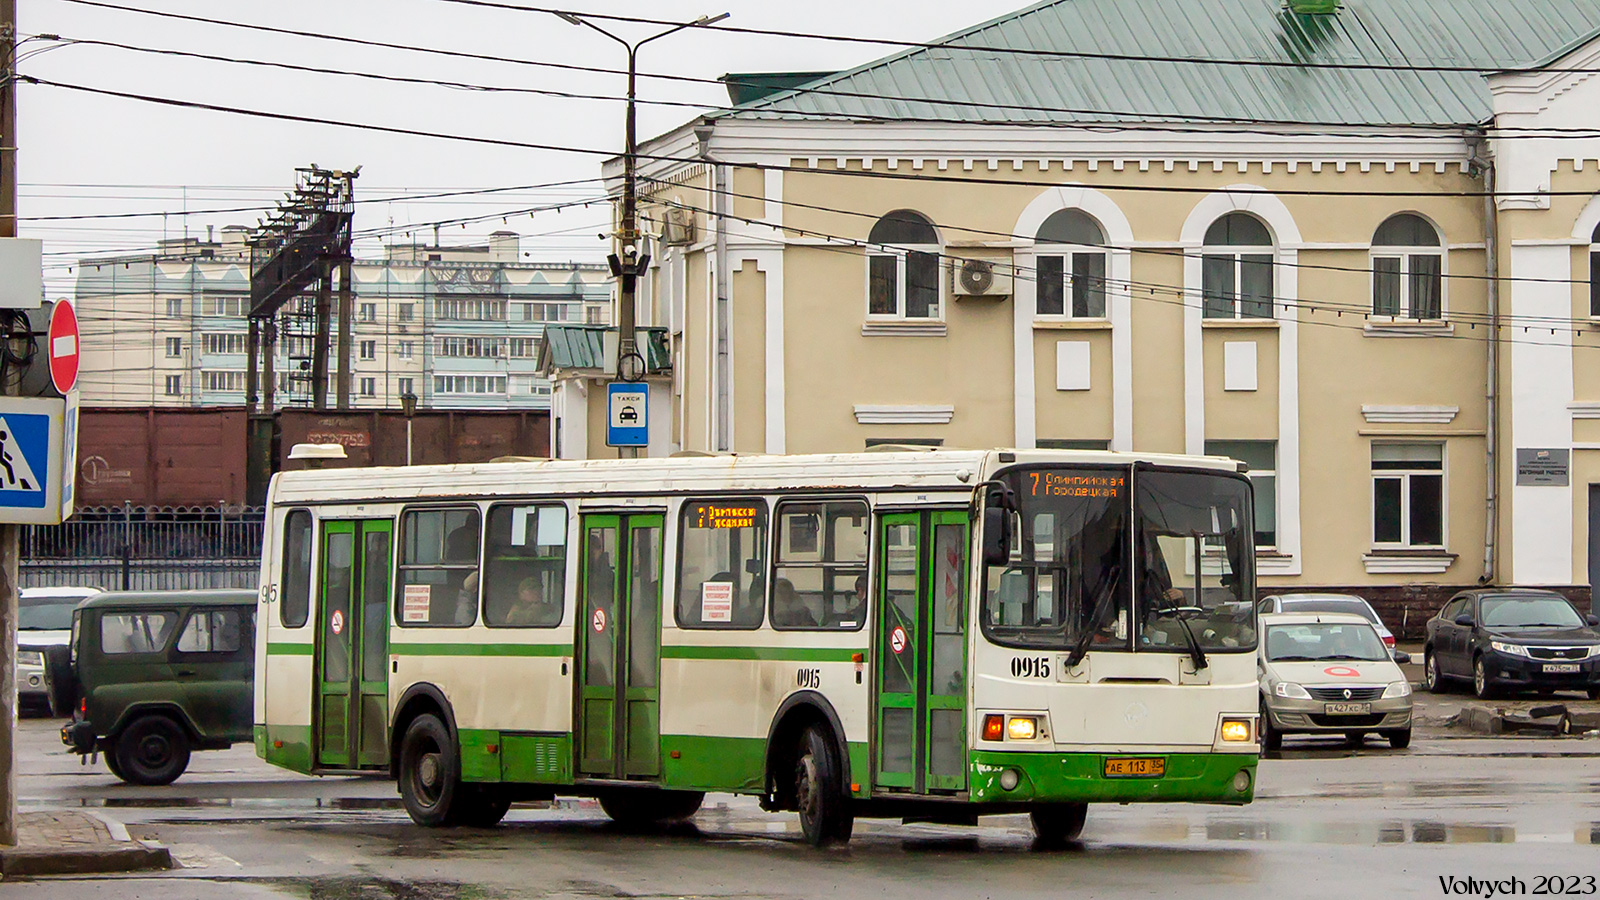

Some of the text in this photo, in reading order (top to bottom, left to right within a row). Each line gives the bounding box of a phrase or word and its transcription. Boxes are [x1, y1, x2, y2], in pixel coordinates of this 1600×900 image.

[1029, 472, 1040, 496] 7
[1010, 656, 1051, 678] 0915
[796, 668, 821, 689] 0915
[1128, 760, 1146, 773] 113
